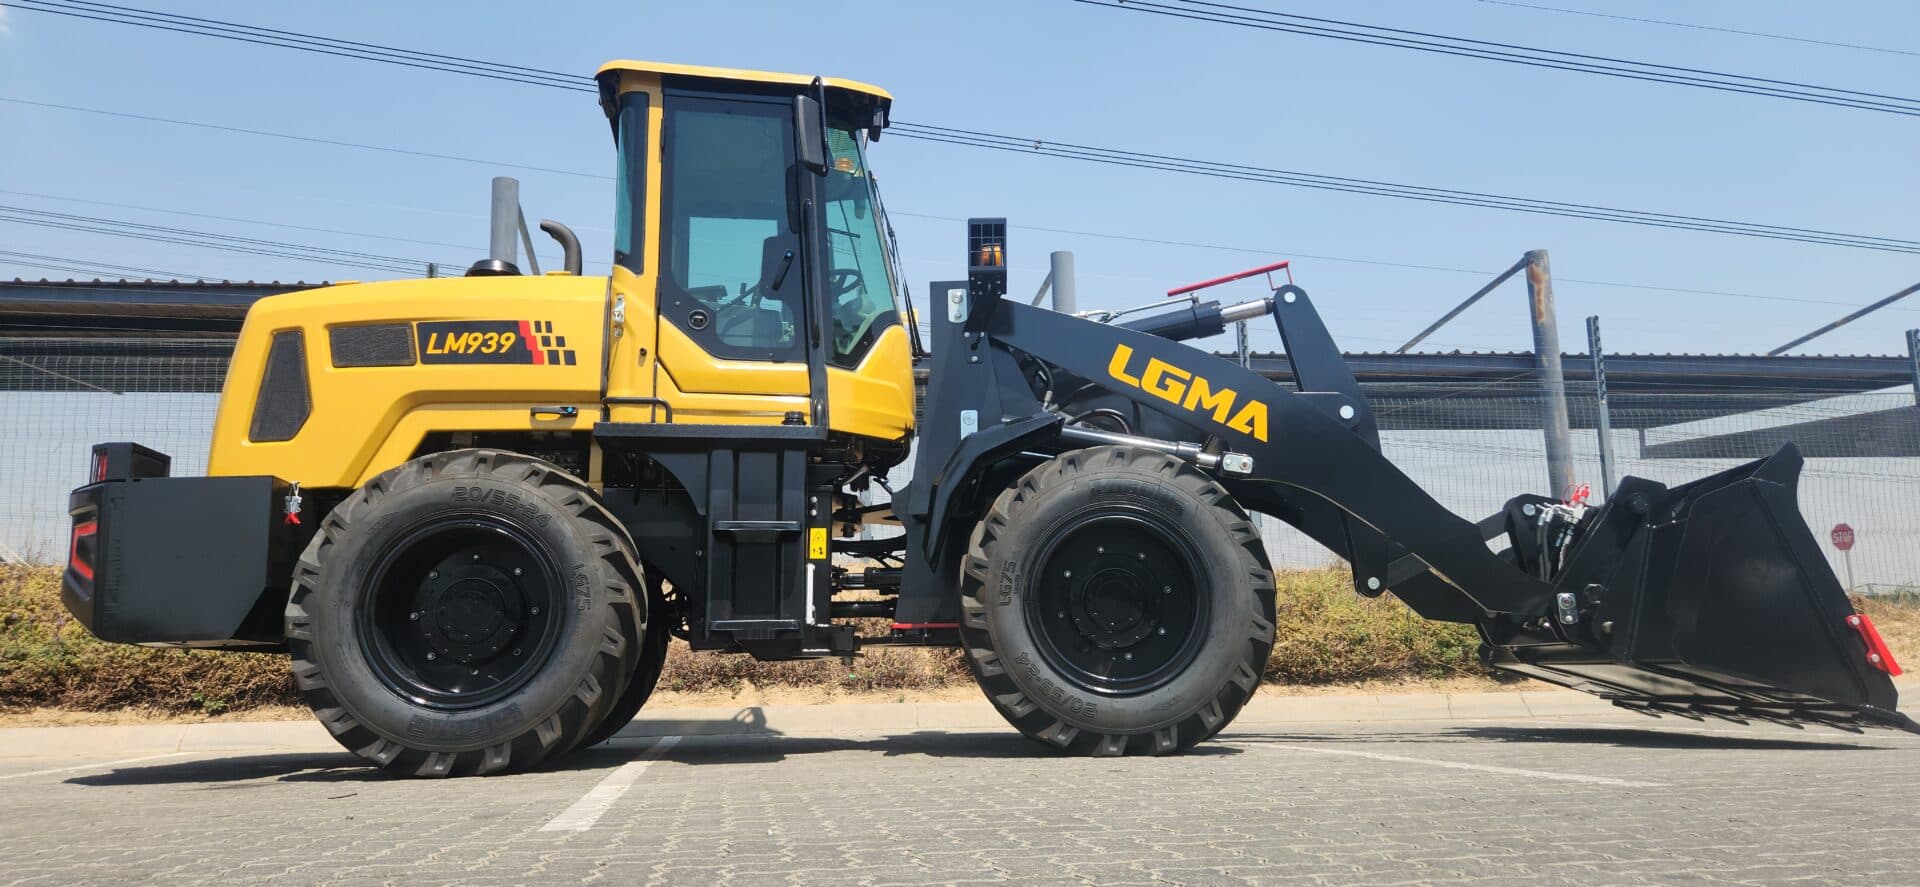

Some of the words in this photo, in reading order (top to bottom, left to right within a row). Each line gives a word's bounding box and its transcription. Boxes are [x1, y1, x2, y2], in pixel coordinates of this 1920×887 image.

[426, 332, 516, 355] LM939
[1108, 343, 1268, 443] LGMA
[1832, 531, 1853, 544] STOP
